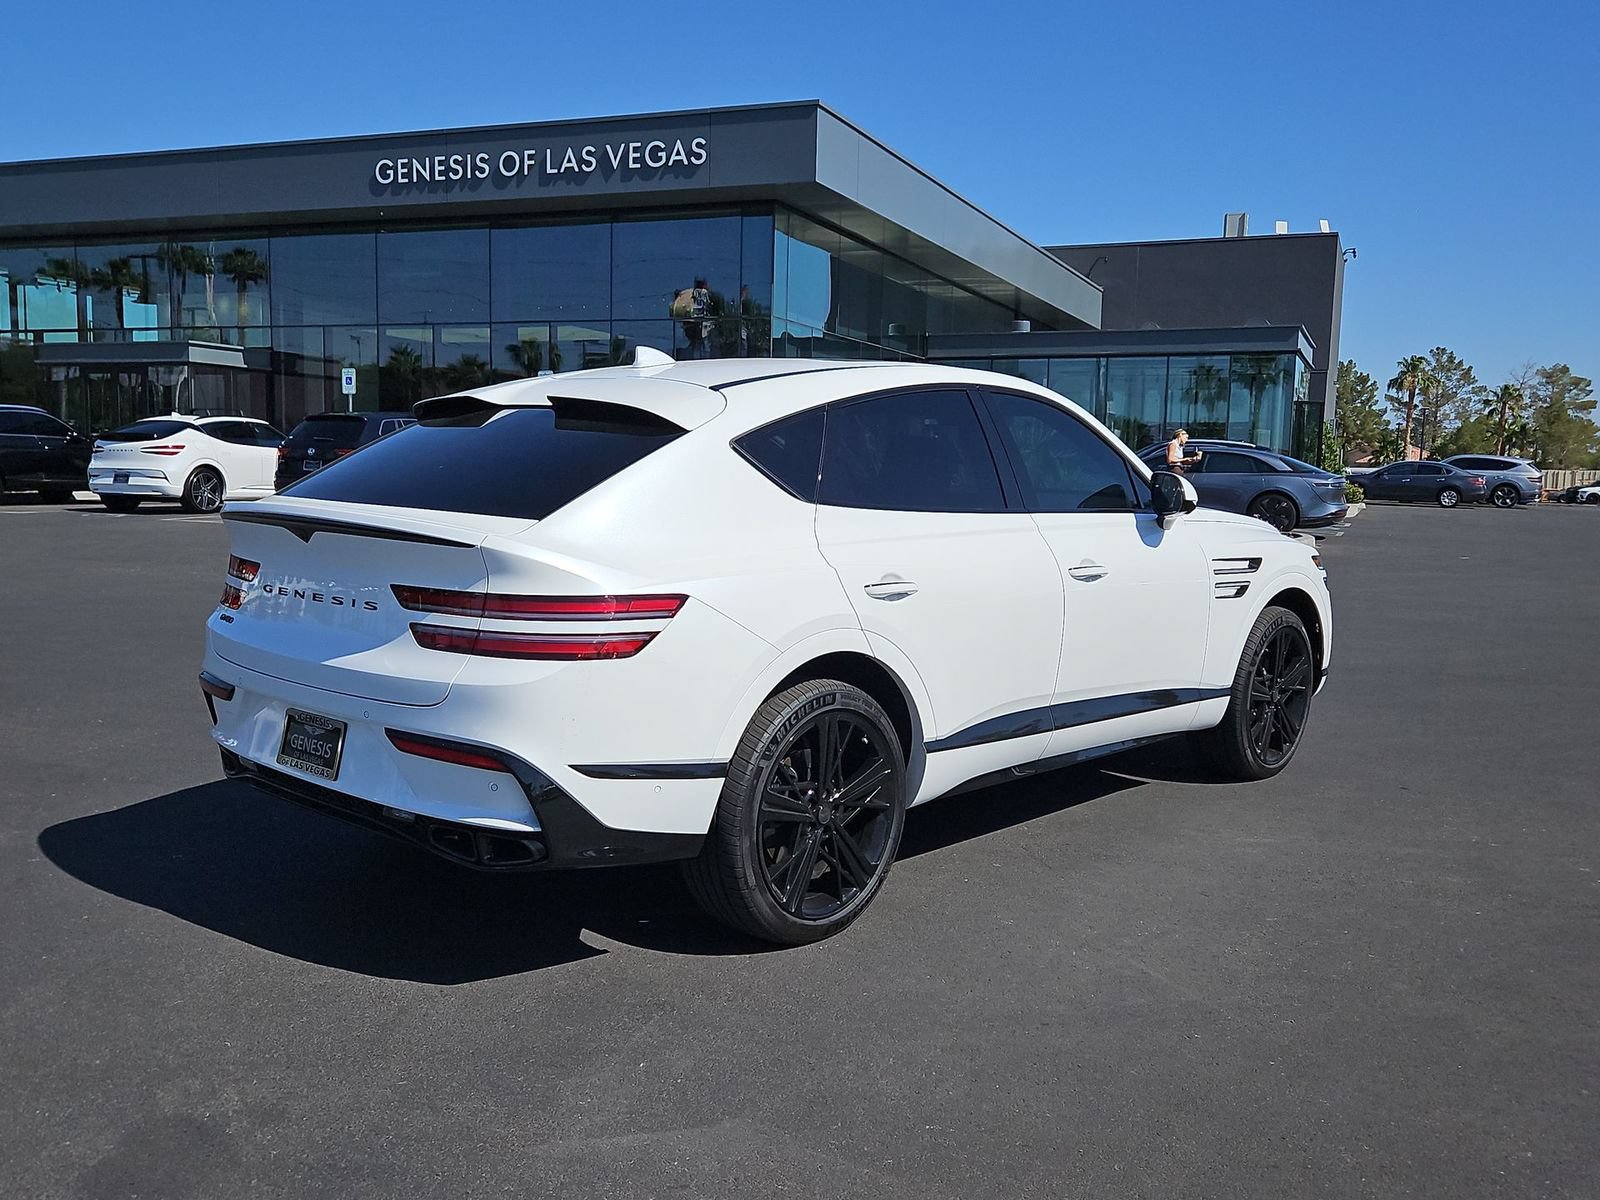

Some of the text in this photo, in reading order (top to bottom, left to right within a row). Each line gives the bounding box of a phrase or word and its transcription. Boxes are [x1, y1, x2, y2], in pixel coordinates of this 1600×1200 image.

[375, 137, 707, 185] GENESIS OF LAS VEGAS
[263, 584, 379, 611] GENESIS
[300, 713, 330, 729] GENESIS
[776, 694, 834, 742] MICHELIN
[290, 734, 332, 758] GENESIS
[289, 759, 304, 770] LAS
[305, 763, 331, 778] VEGAS
